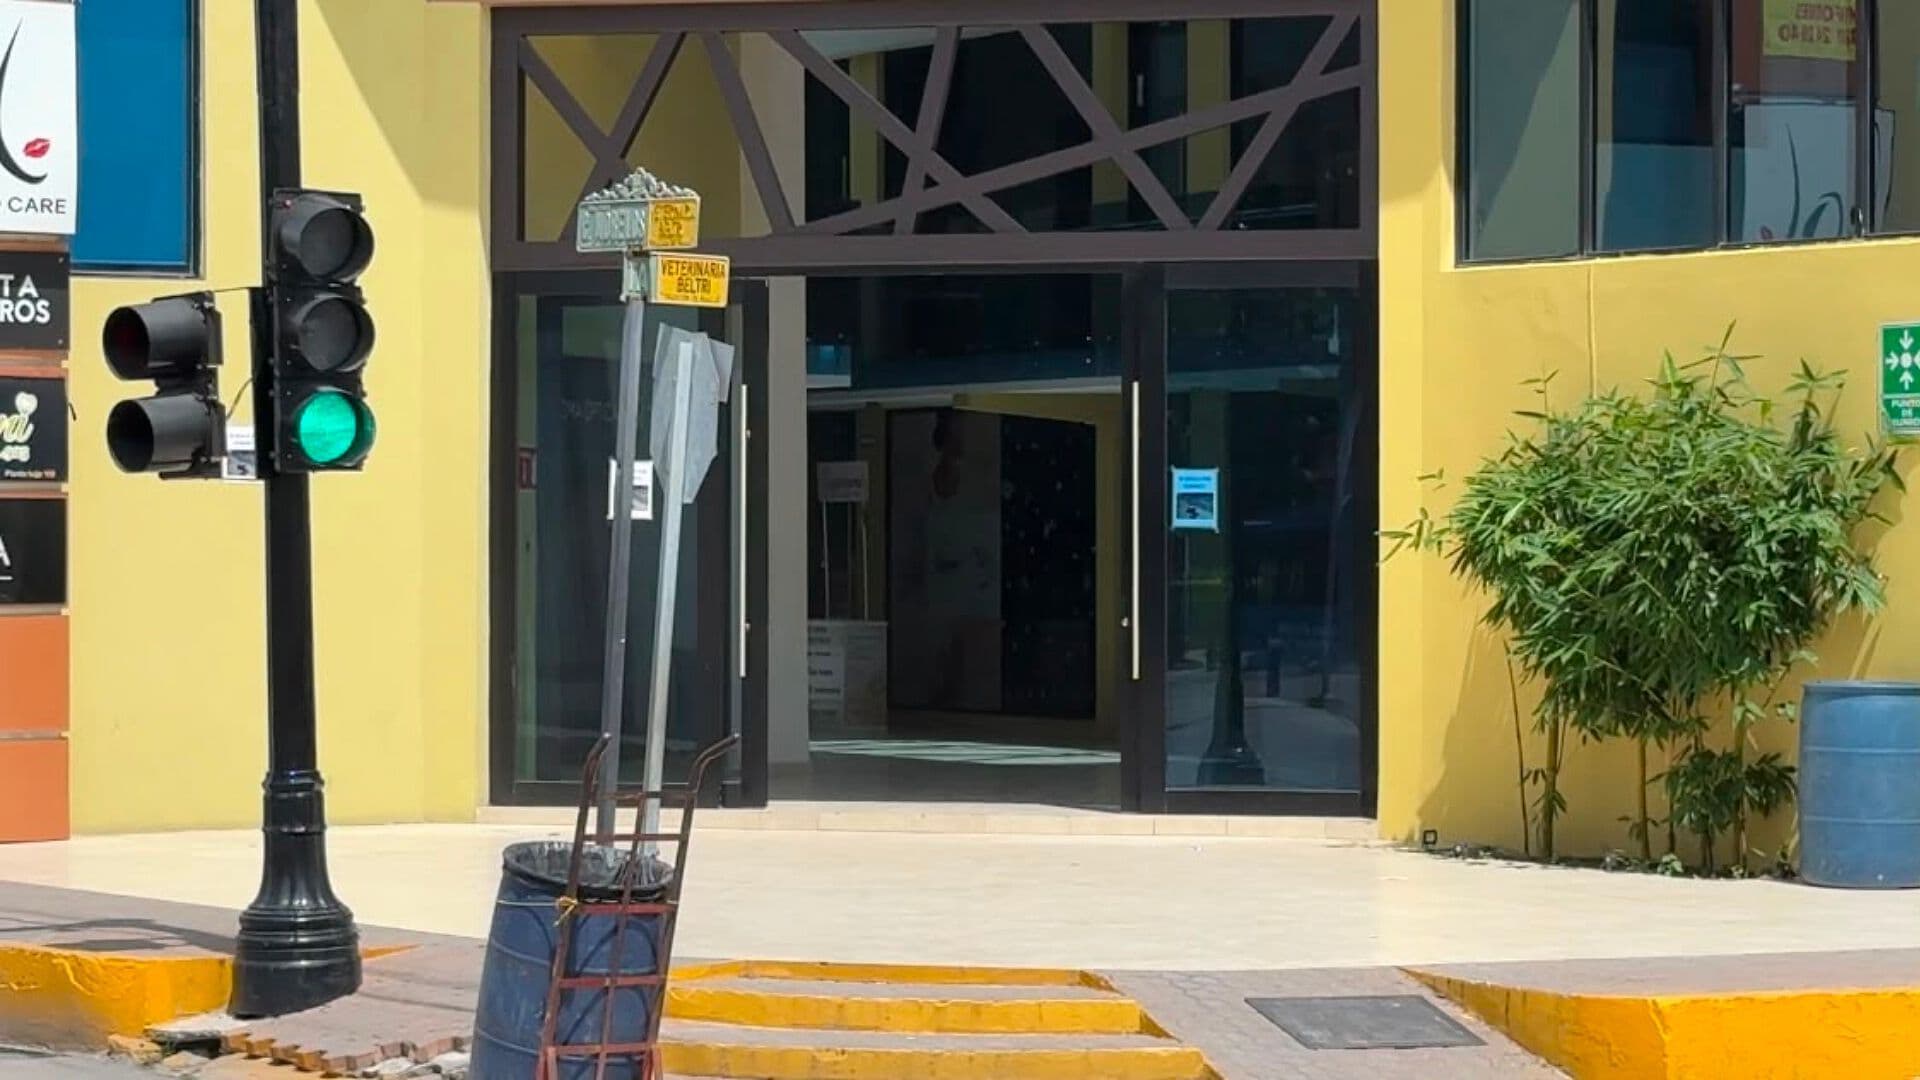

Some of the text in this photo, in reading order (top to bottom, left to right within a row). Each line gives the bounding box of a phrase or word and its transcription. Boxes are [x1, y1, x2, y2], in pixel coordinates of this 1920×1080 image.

[8, 196, 67, 214] CARE
[661, 259, 726, 279] VETERINARIA
[677, 276, 712, 294] BELTRI
[0, 298, 51, 324] ROS
